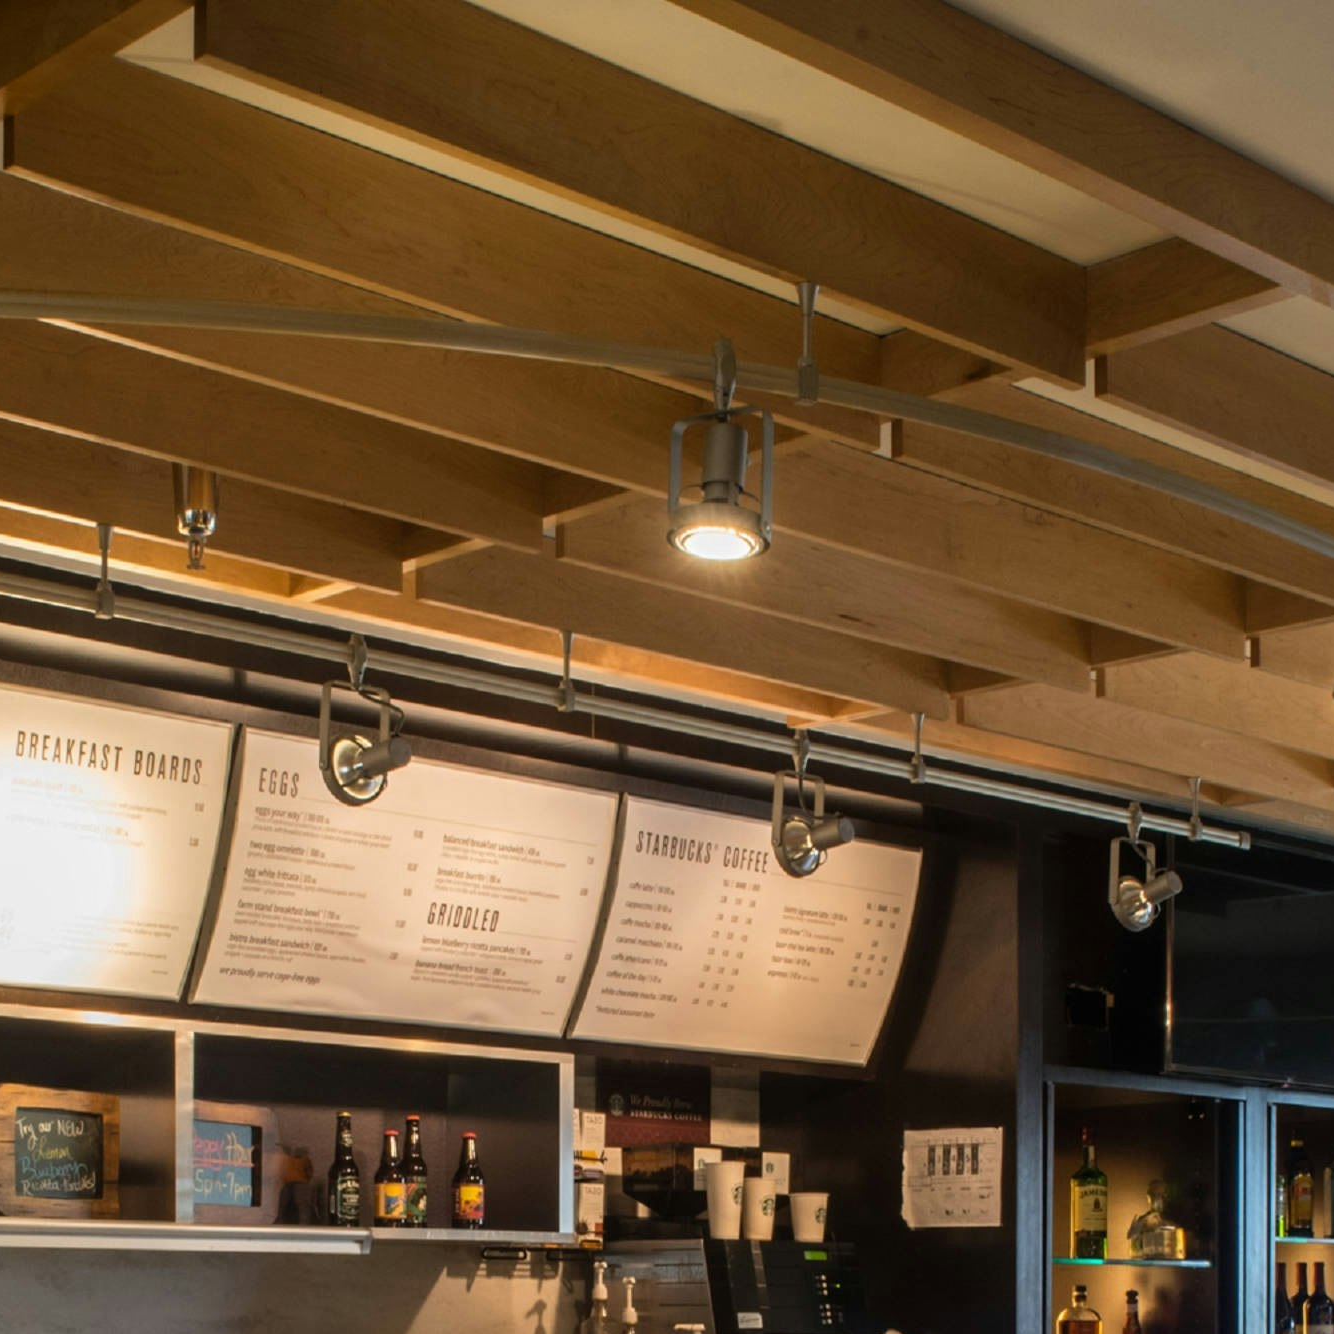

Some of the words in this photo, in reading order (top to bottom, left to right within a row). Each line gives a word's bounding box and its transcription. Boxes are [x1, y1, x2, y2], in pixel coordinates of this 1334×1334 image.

[15, 729, 124, 773] BREAKFAST
[133, 749, 204, 785] BOARDS
[258, 767, 300, 799] EGGS
[635, 830, 713, 865] STARBUCKS
[722, 845, 770, 874] COFFEE
[427, 901, 501, 933] GRIDDLED
[16, 1116, 38, 1153] Try
